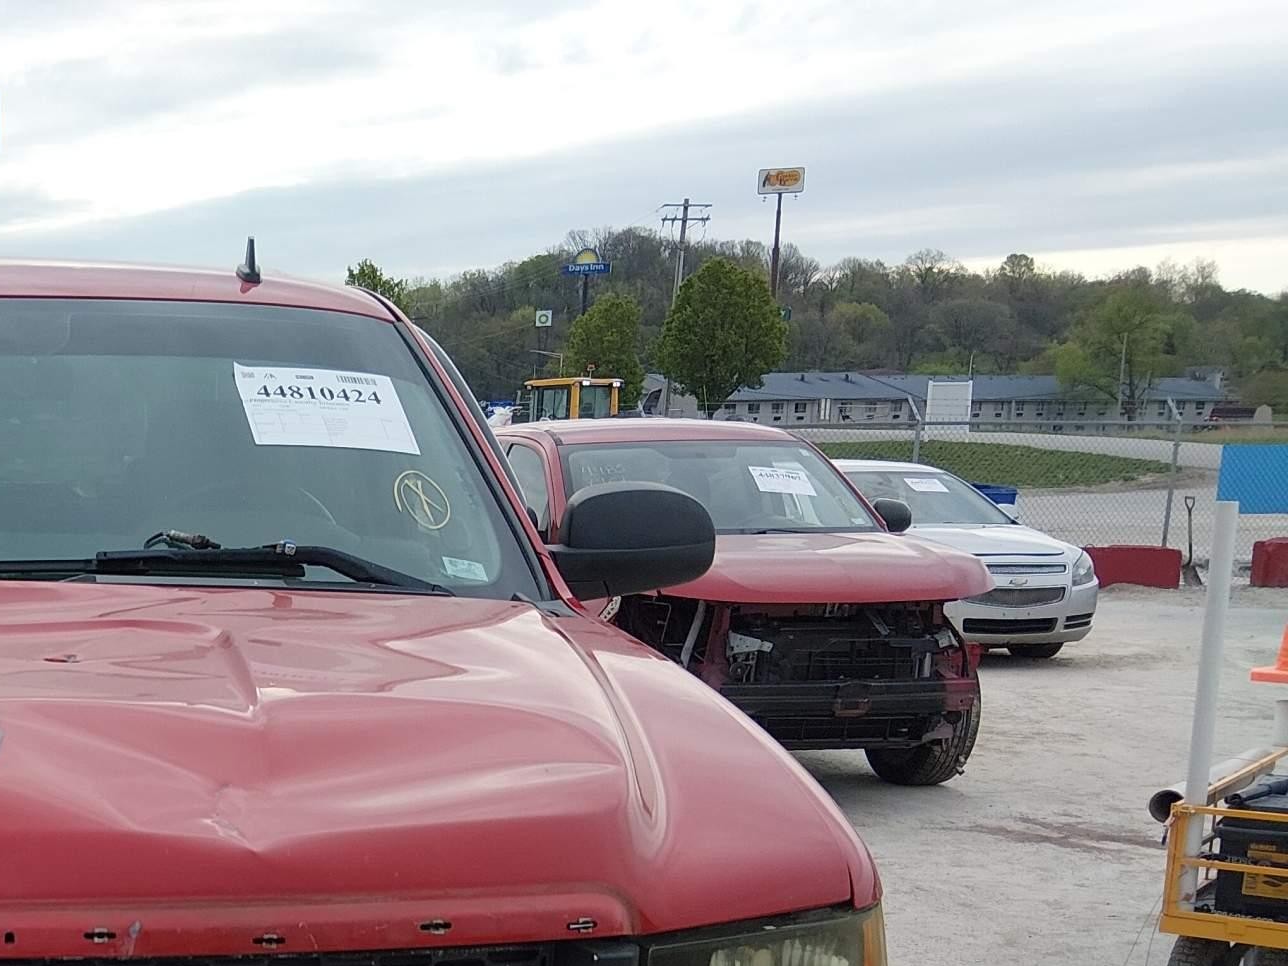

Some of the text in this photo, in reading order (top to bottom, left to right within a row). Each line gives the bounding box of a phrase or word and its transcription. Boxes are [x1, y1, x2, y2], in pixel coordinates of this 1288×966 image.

[568, 263, 604, 273] Days Inn
[256, 384, 382, 405] 44810424
